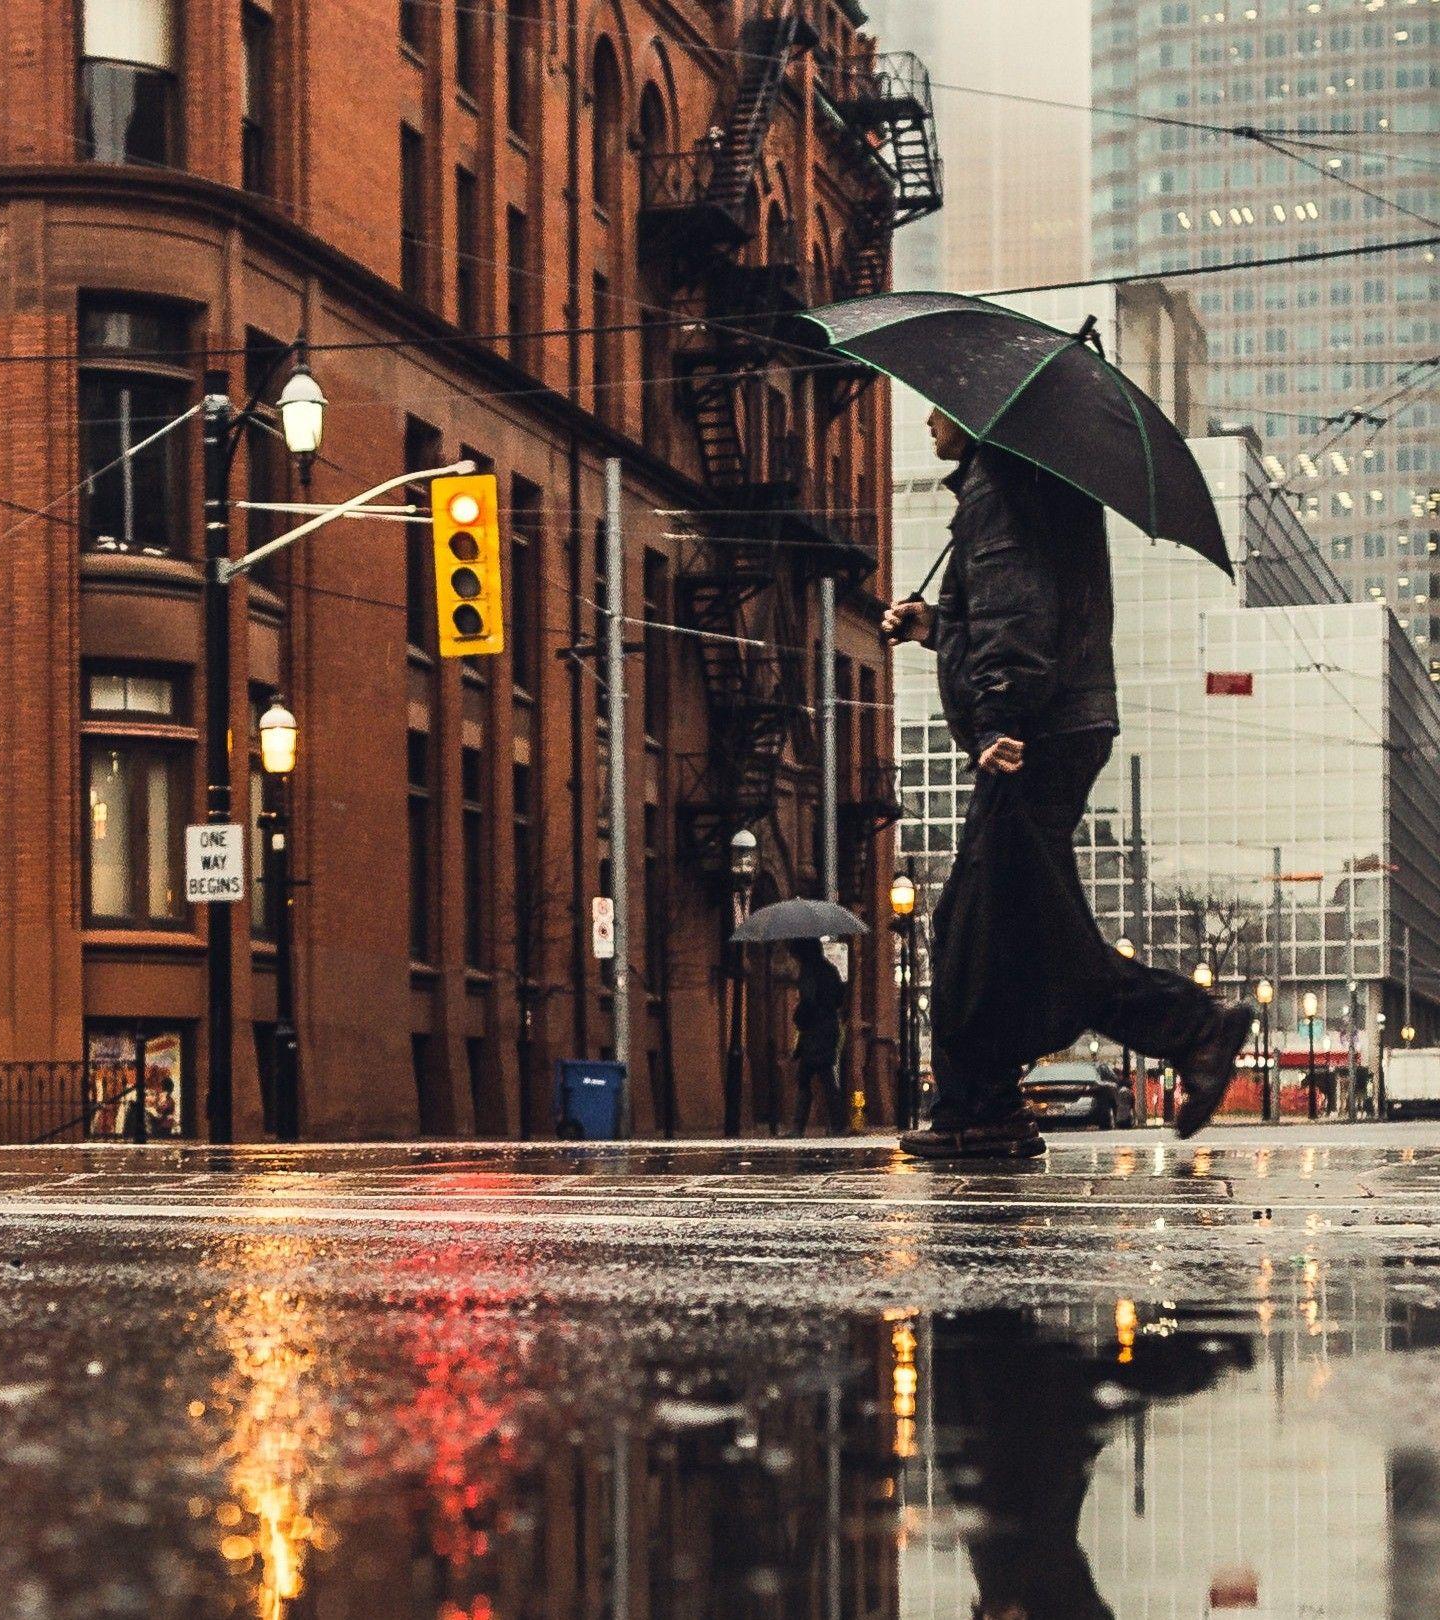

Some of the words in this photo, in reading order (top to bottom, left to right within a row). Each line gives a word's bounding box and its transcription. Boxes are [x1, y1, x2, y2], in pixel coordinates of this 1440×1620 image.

[200, 831, 227, 847] ONE
[201, 855, 227, 870] WAY
[189, 877, 240, 894] BEGINS
